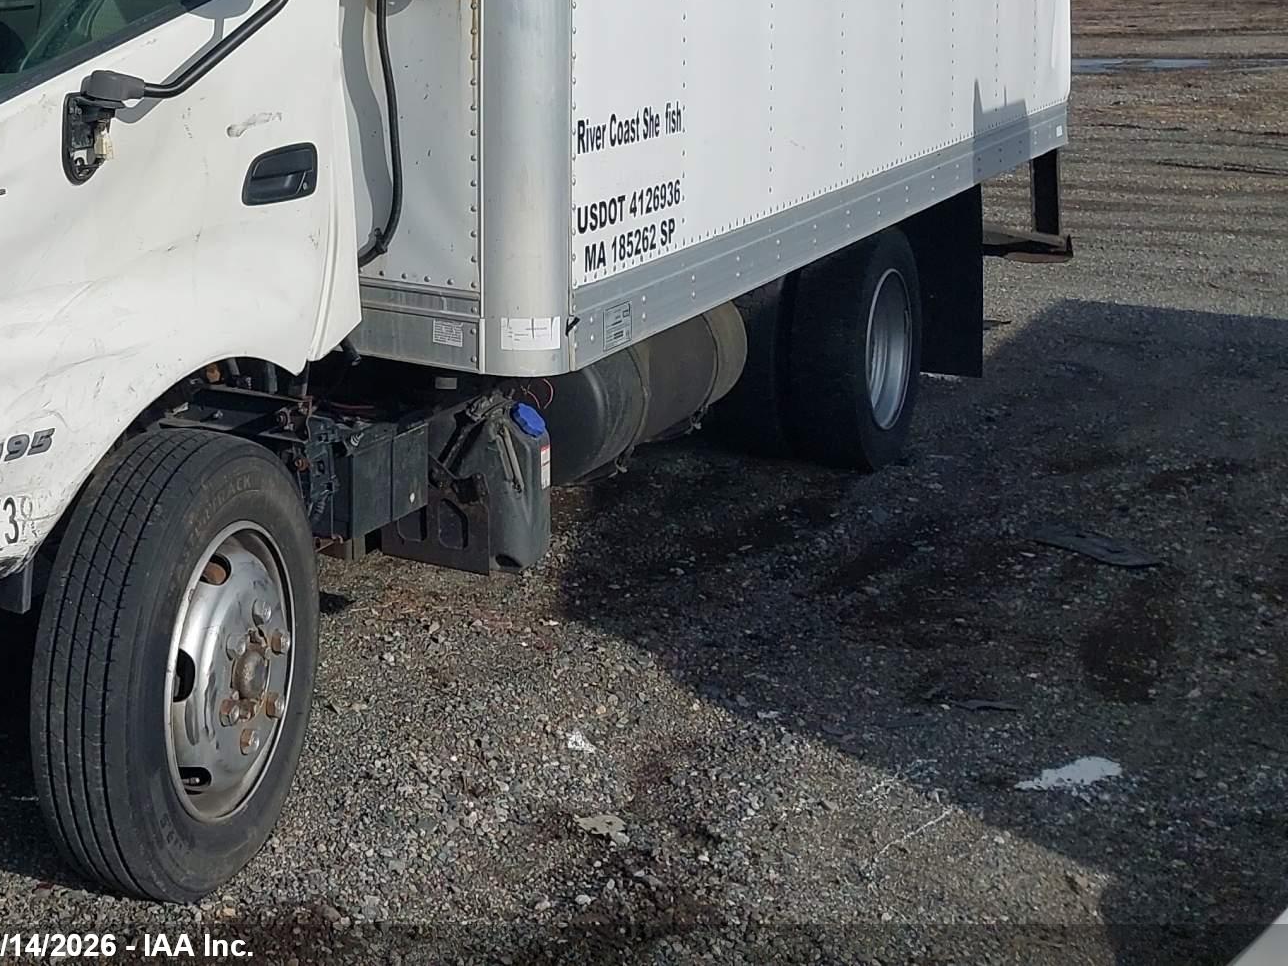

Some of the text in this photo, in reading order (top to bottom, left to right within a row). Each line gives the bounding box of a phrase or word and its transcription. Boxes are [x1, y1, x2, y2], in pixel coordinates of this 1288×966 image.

[577, 101, 682, 154] River Coast She fish
[577, 179, 681, 234] USDOT 4126936
[584, 218, 675, 273] MA 185262 SP
